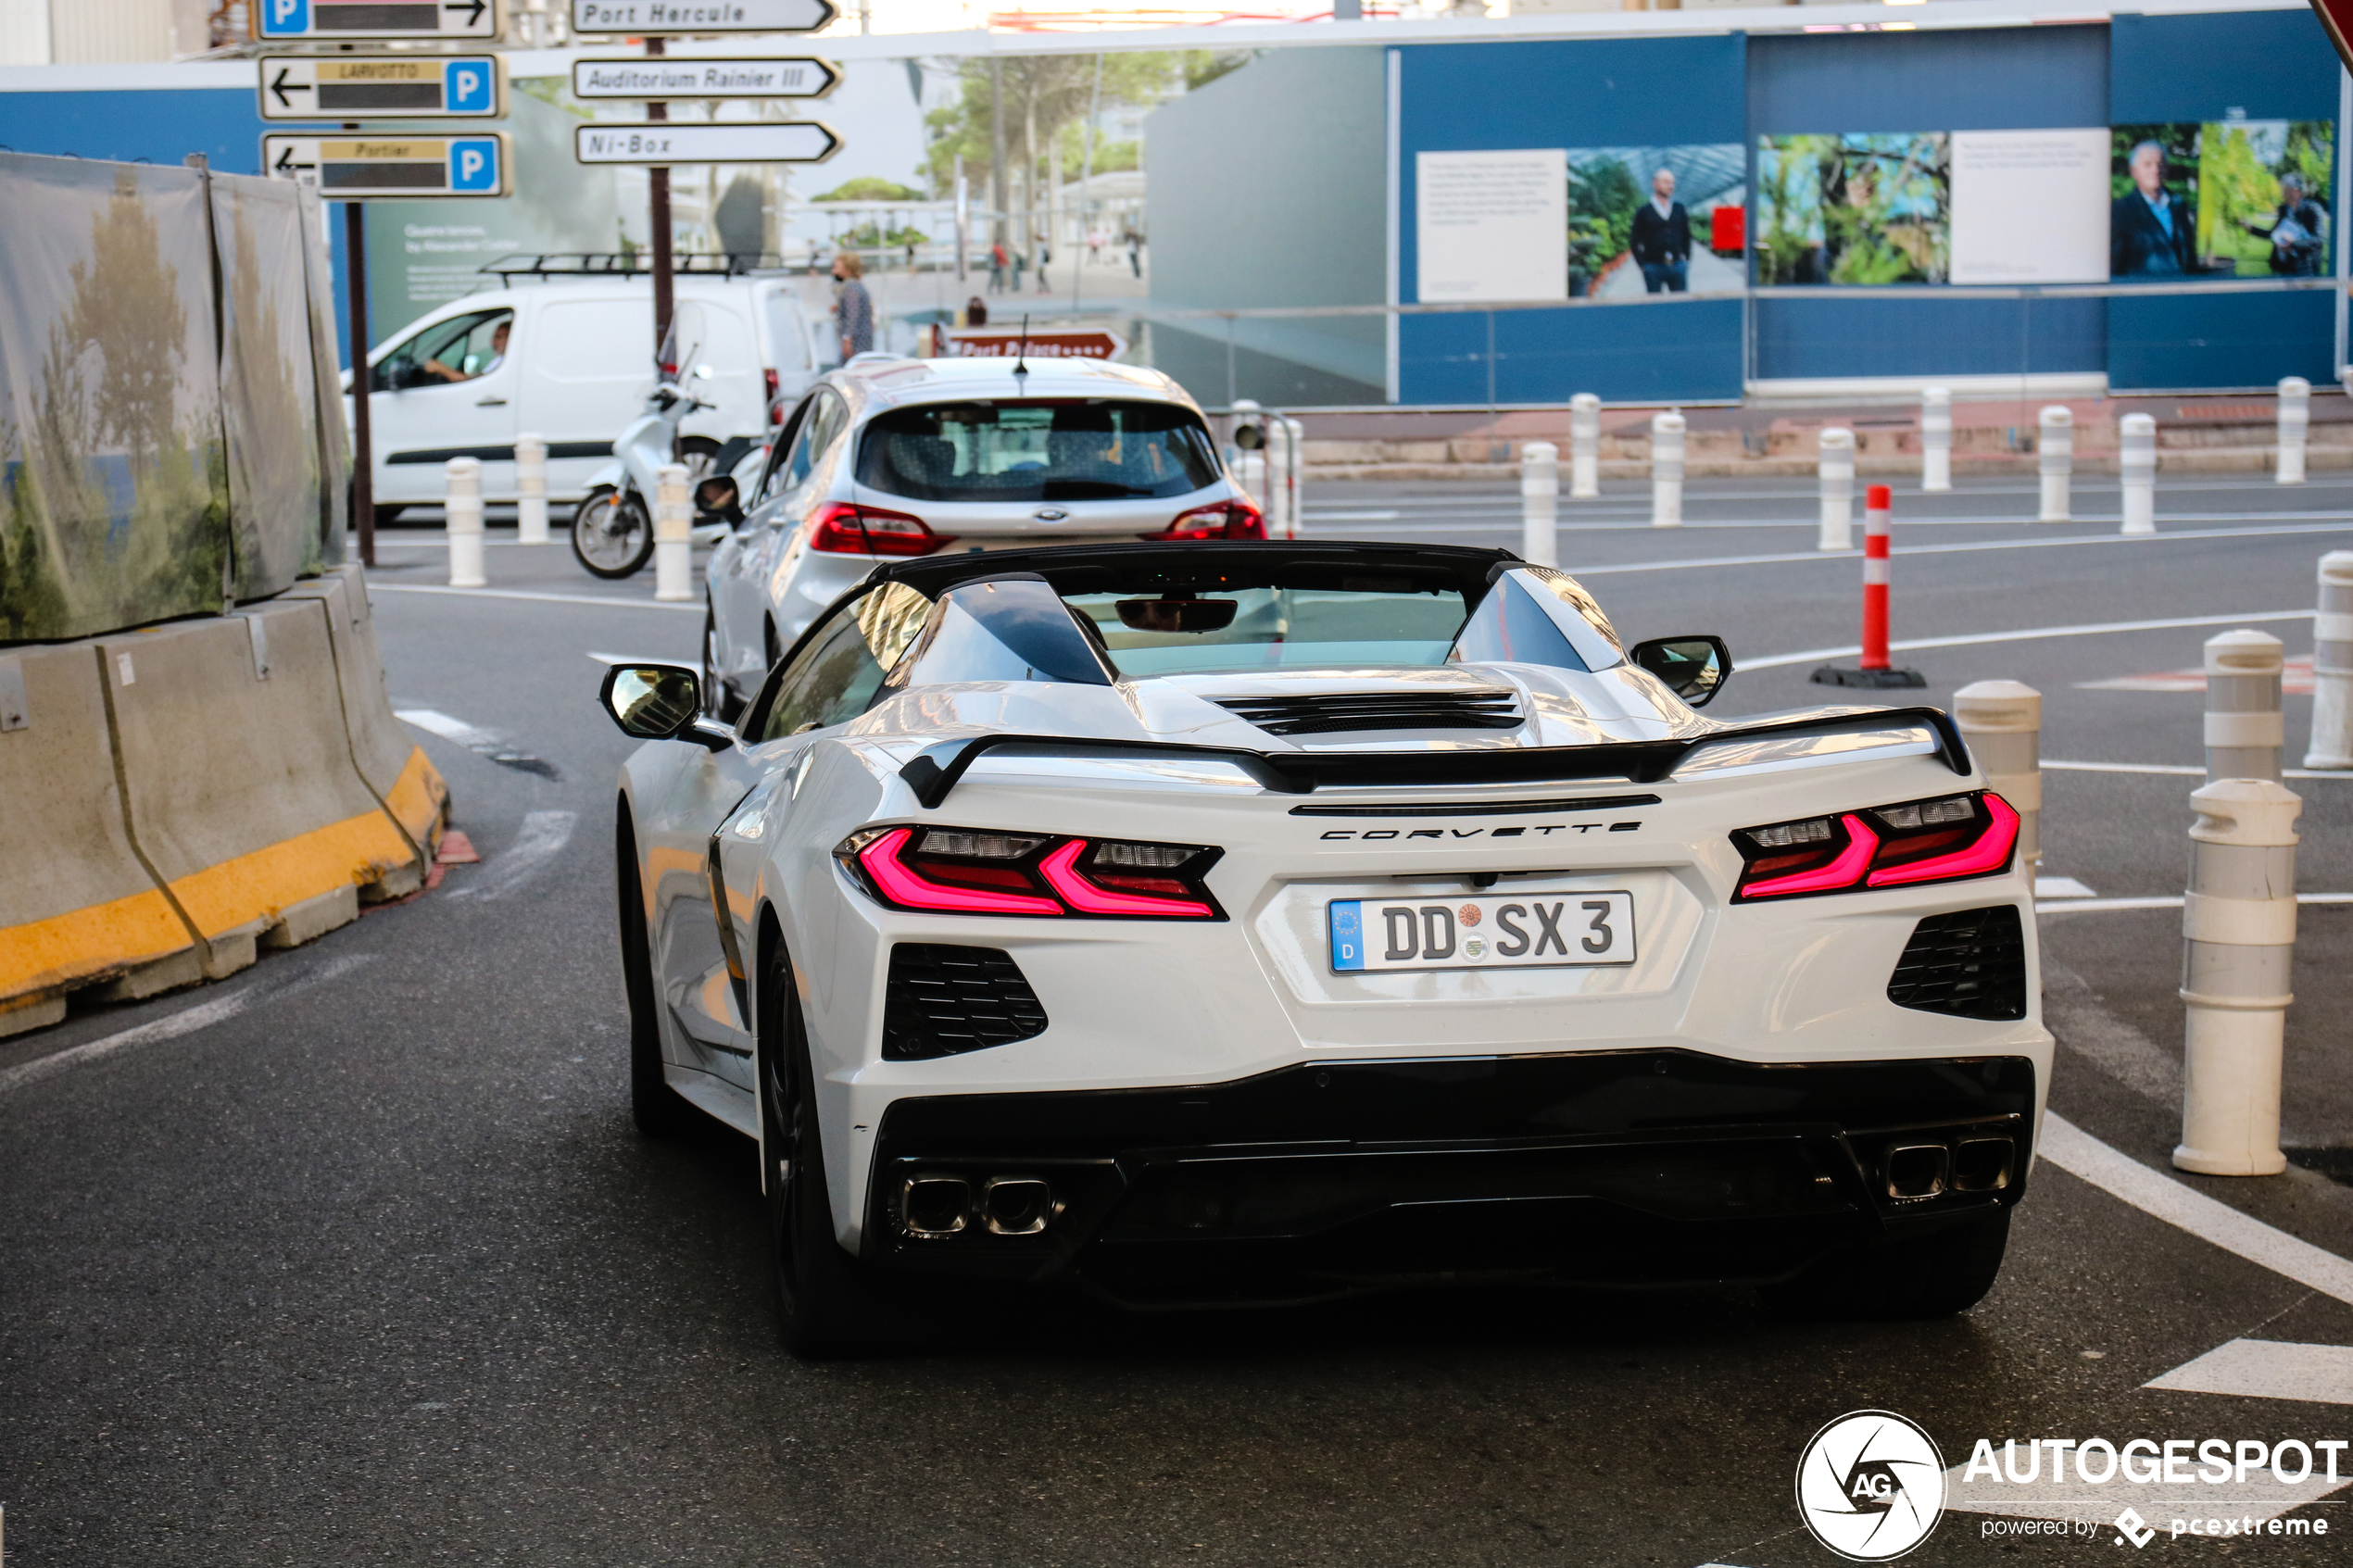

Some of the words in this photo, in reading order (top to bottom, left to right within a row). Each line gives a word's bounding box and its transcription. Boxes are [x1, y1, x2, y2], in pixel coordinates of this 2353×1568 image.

[274, 0, 297, 25] P
[583, 5, 636, 23] Port
[649, 4, 746, 23] Hercule
[456, 69, 479, 103] P
[586, 69, 698, 89] Auditorium
[703, 69, 774, 88] Rainier
[588, 135, 672, 154] Ni-Box
[461, 149, 484, 182] P
[1320, 821, 1642, 840] CORVETTE
[1382, 906, 1456, 960] DD
[1495, 902, 1568, 957] SX
[1580, 900, 1613, 954] 3
[1342, 944, 1354, 960] D
